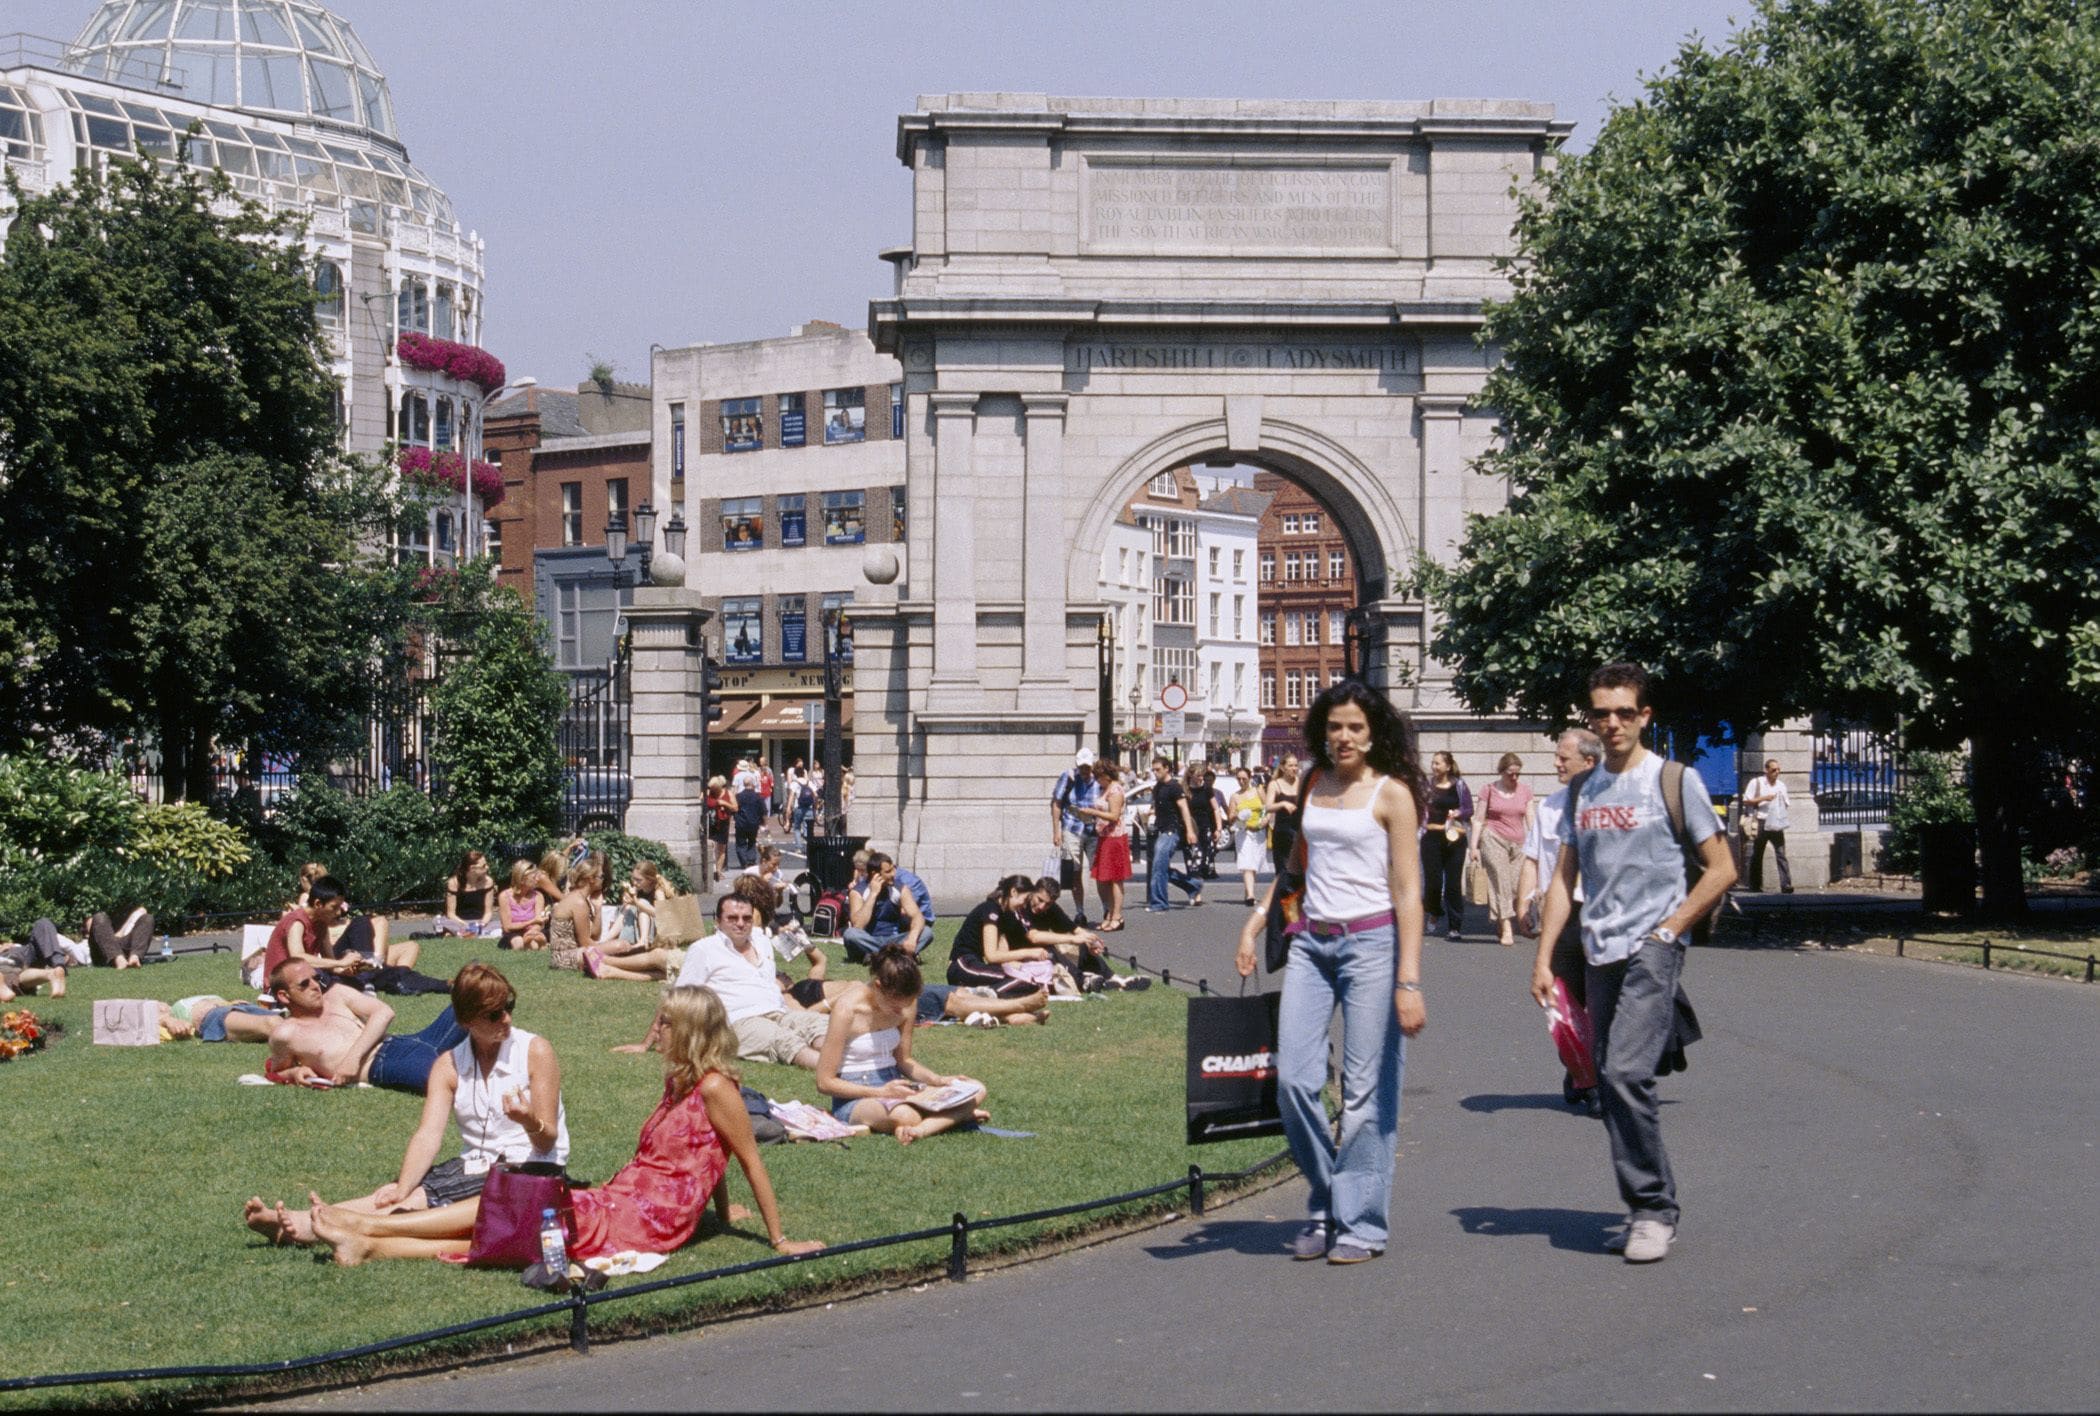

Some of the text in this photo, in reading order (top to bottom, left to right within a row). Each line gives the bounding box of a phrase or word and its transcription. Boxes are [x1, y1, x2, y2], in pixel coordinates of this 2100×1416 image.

[1253, 190, 1284, 203] AND
[1076, 346, 1406, 370] HARTSHILL LADYSMITH
